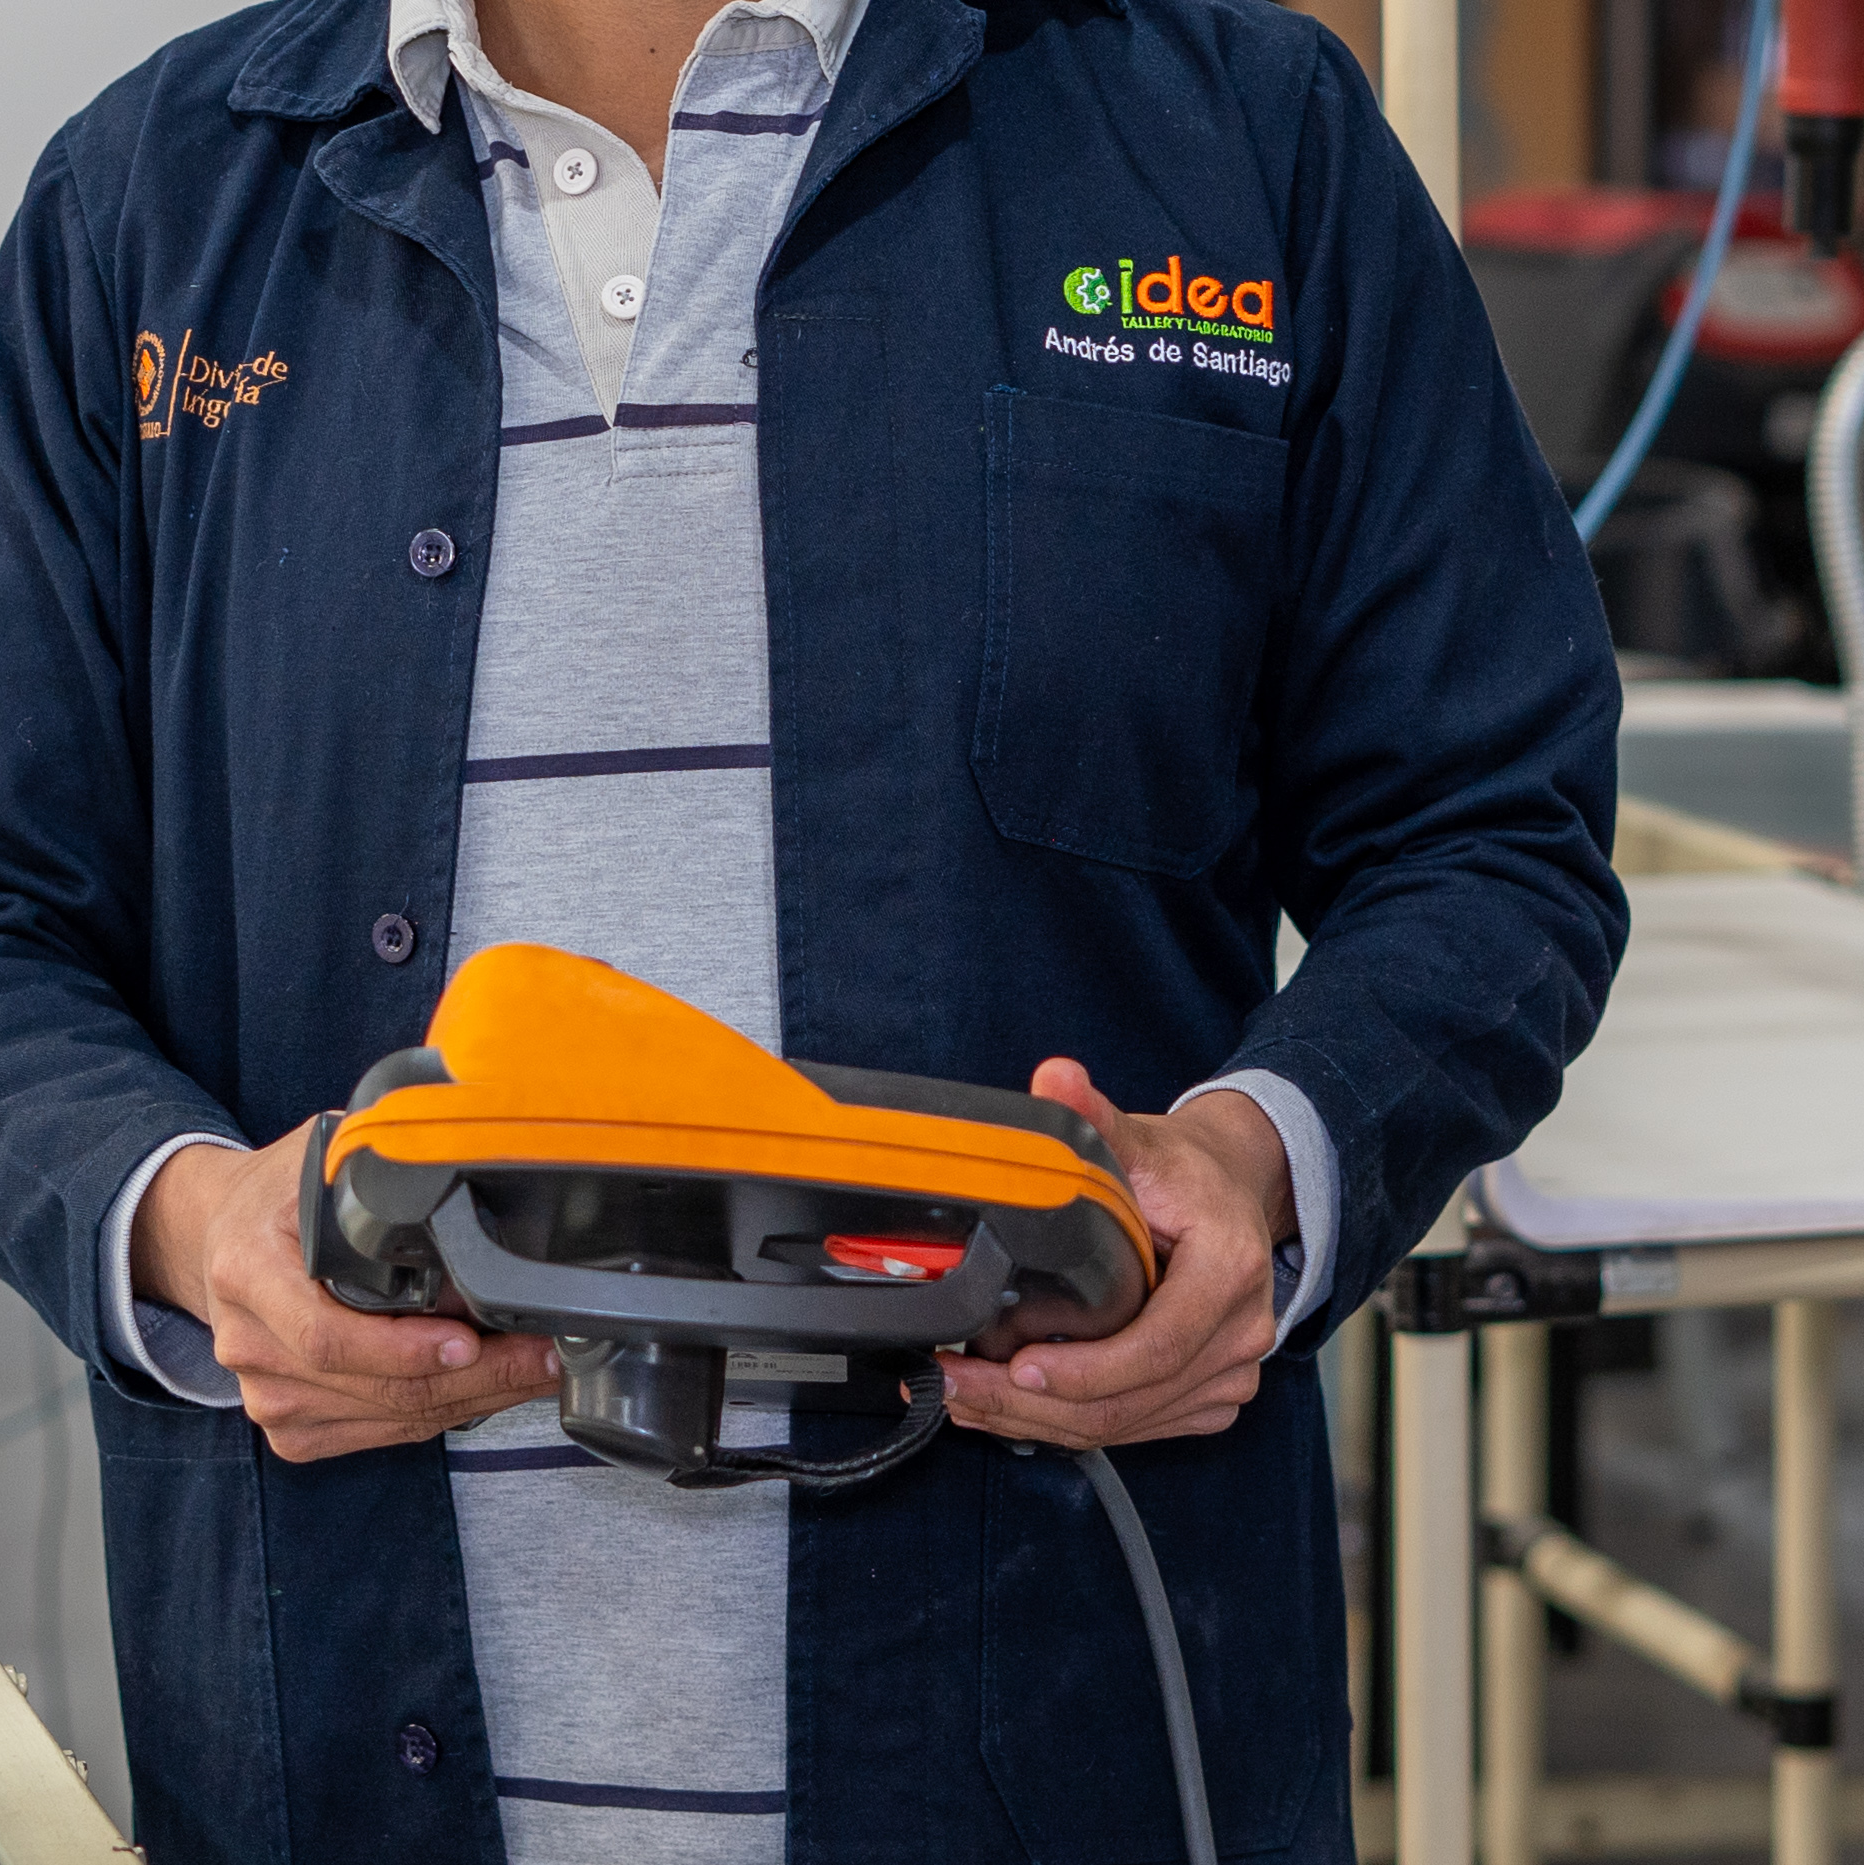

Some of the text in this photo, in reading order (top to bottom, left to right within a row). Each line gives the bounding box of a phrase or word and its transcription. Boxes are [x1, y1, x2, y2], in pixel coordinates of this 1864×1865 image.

[1118, 255, 1275, 330] idea
[1121, 316, 1274, 345] TALLER Y LABORATORIO
[252, 351, 289, 381] de
[1045, 326, 1292, 387] Andrés de Santiago
